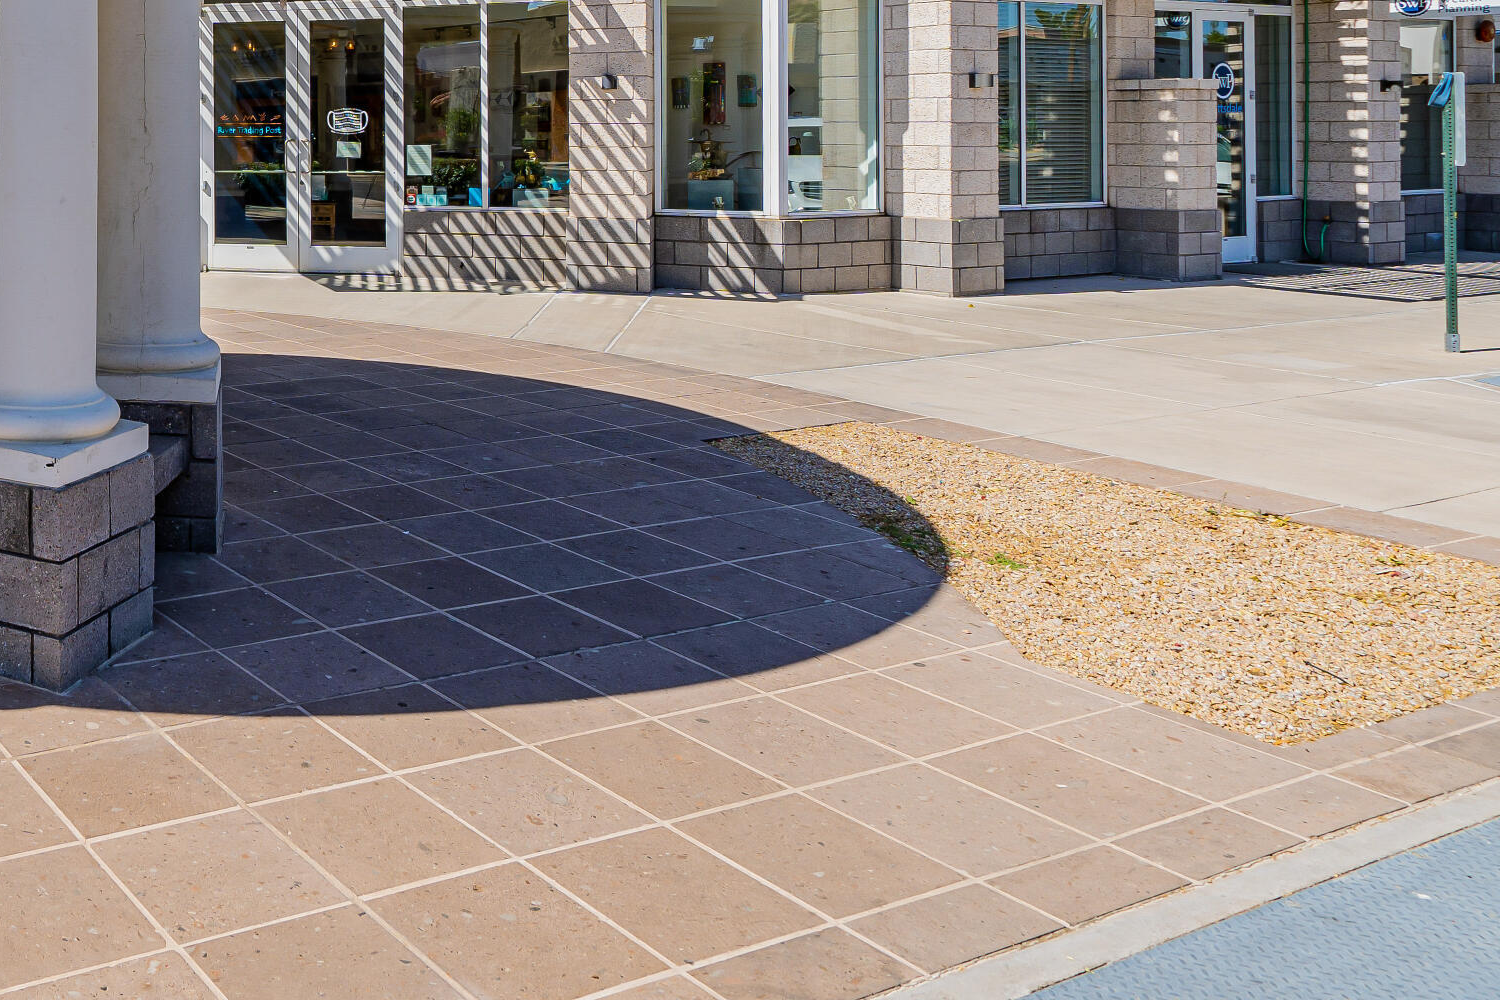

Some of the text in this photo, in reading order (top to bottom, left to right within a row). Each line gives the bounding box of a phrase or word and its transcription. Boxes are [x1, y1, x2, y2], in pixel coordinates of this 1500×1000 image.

[1438, 4, 1491, 13] Planning
[217, 126, 282, 136] River Trading Post
